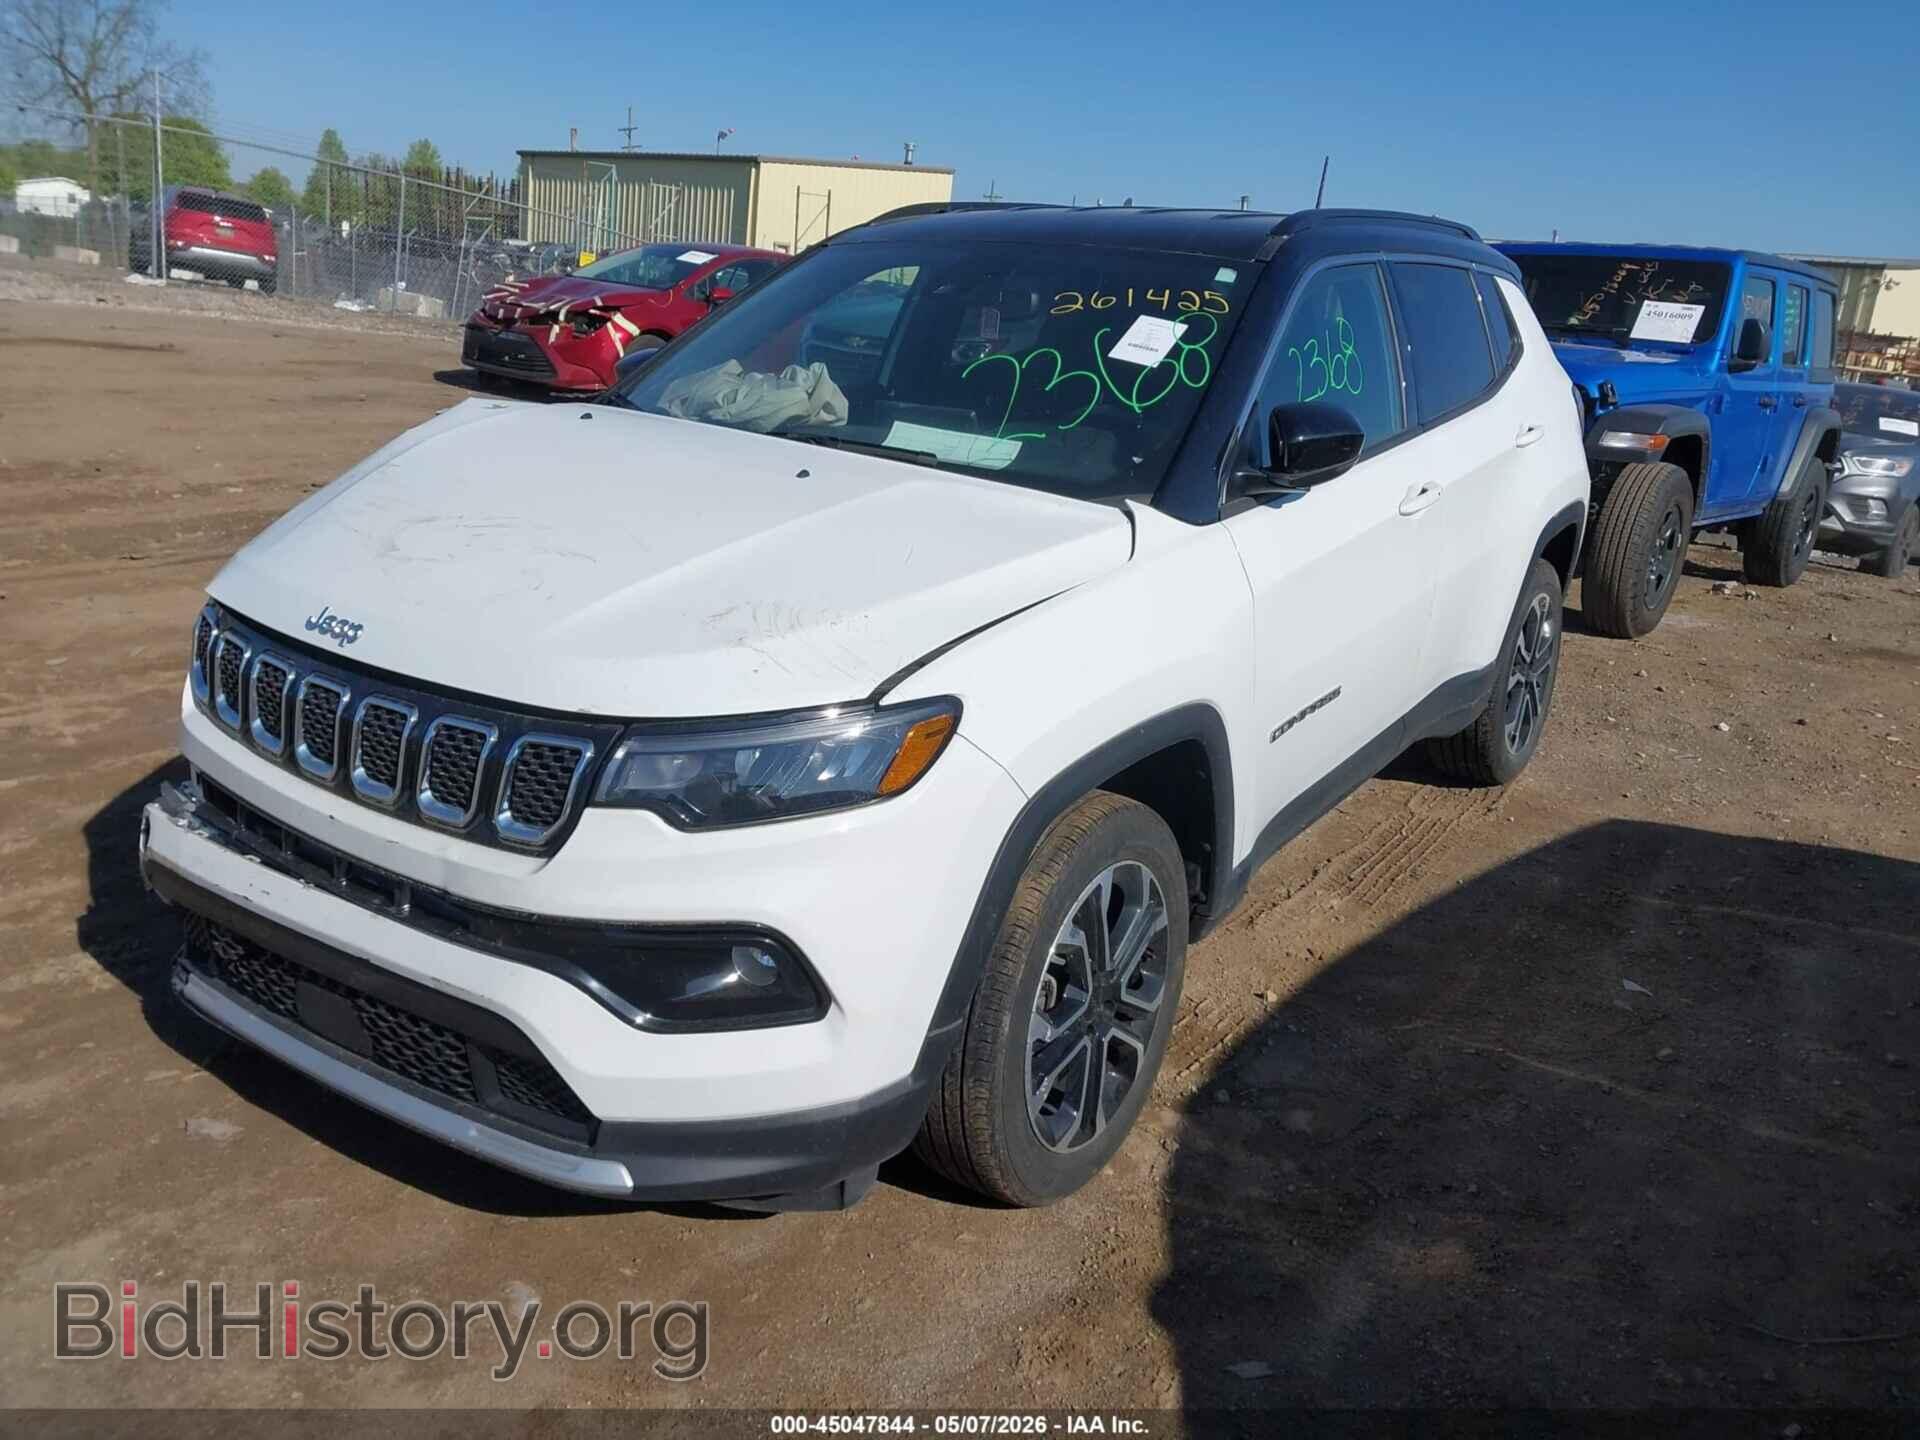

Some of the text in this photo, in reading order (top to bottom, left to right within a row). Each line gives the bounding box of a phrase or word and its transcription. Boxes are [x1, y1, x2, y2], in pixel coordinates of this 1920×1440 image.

[1050, 287, 1230, 314] 261425
[961, 311, 1218, 442] 2368
[1288, 316, 1363, 402] 2368
[304, 606, 364, 648] Jeep
[1269, 684, 1342, 744] COMPASS
